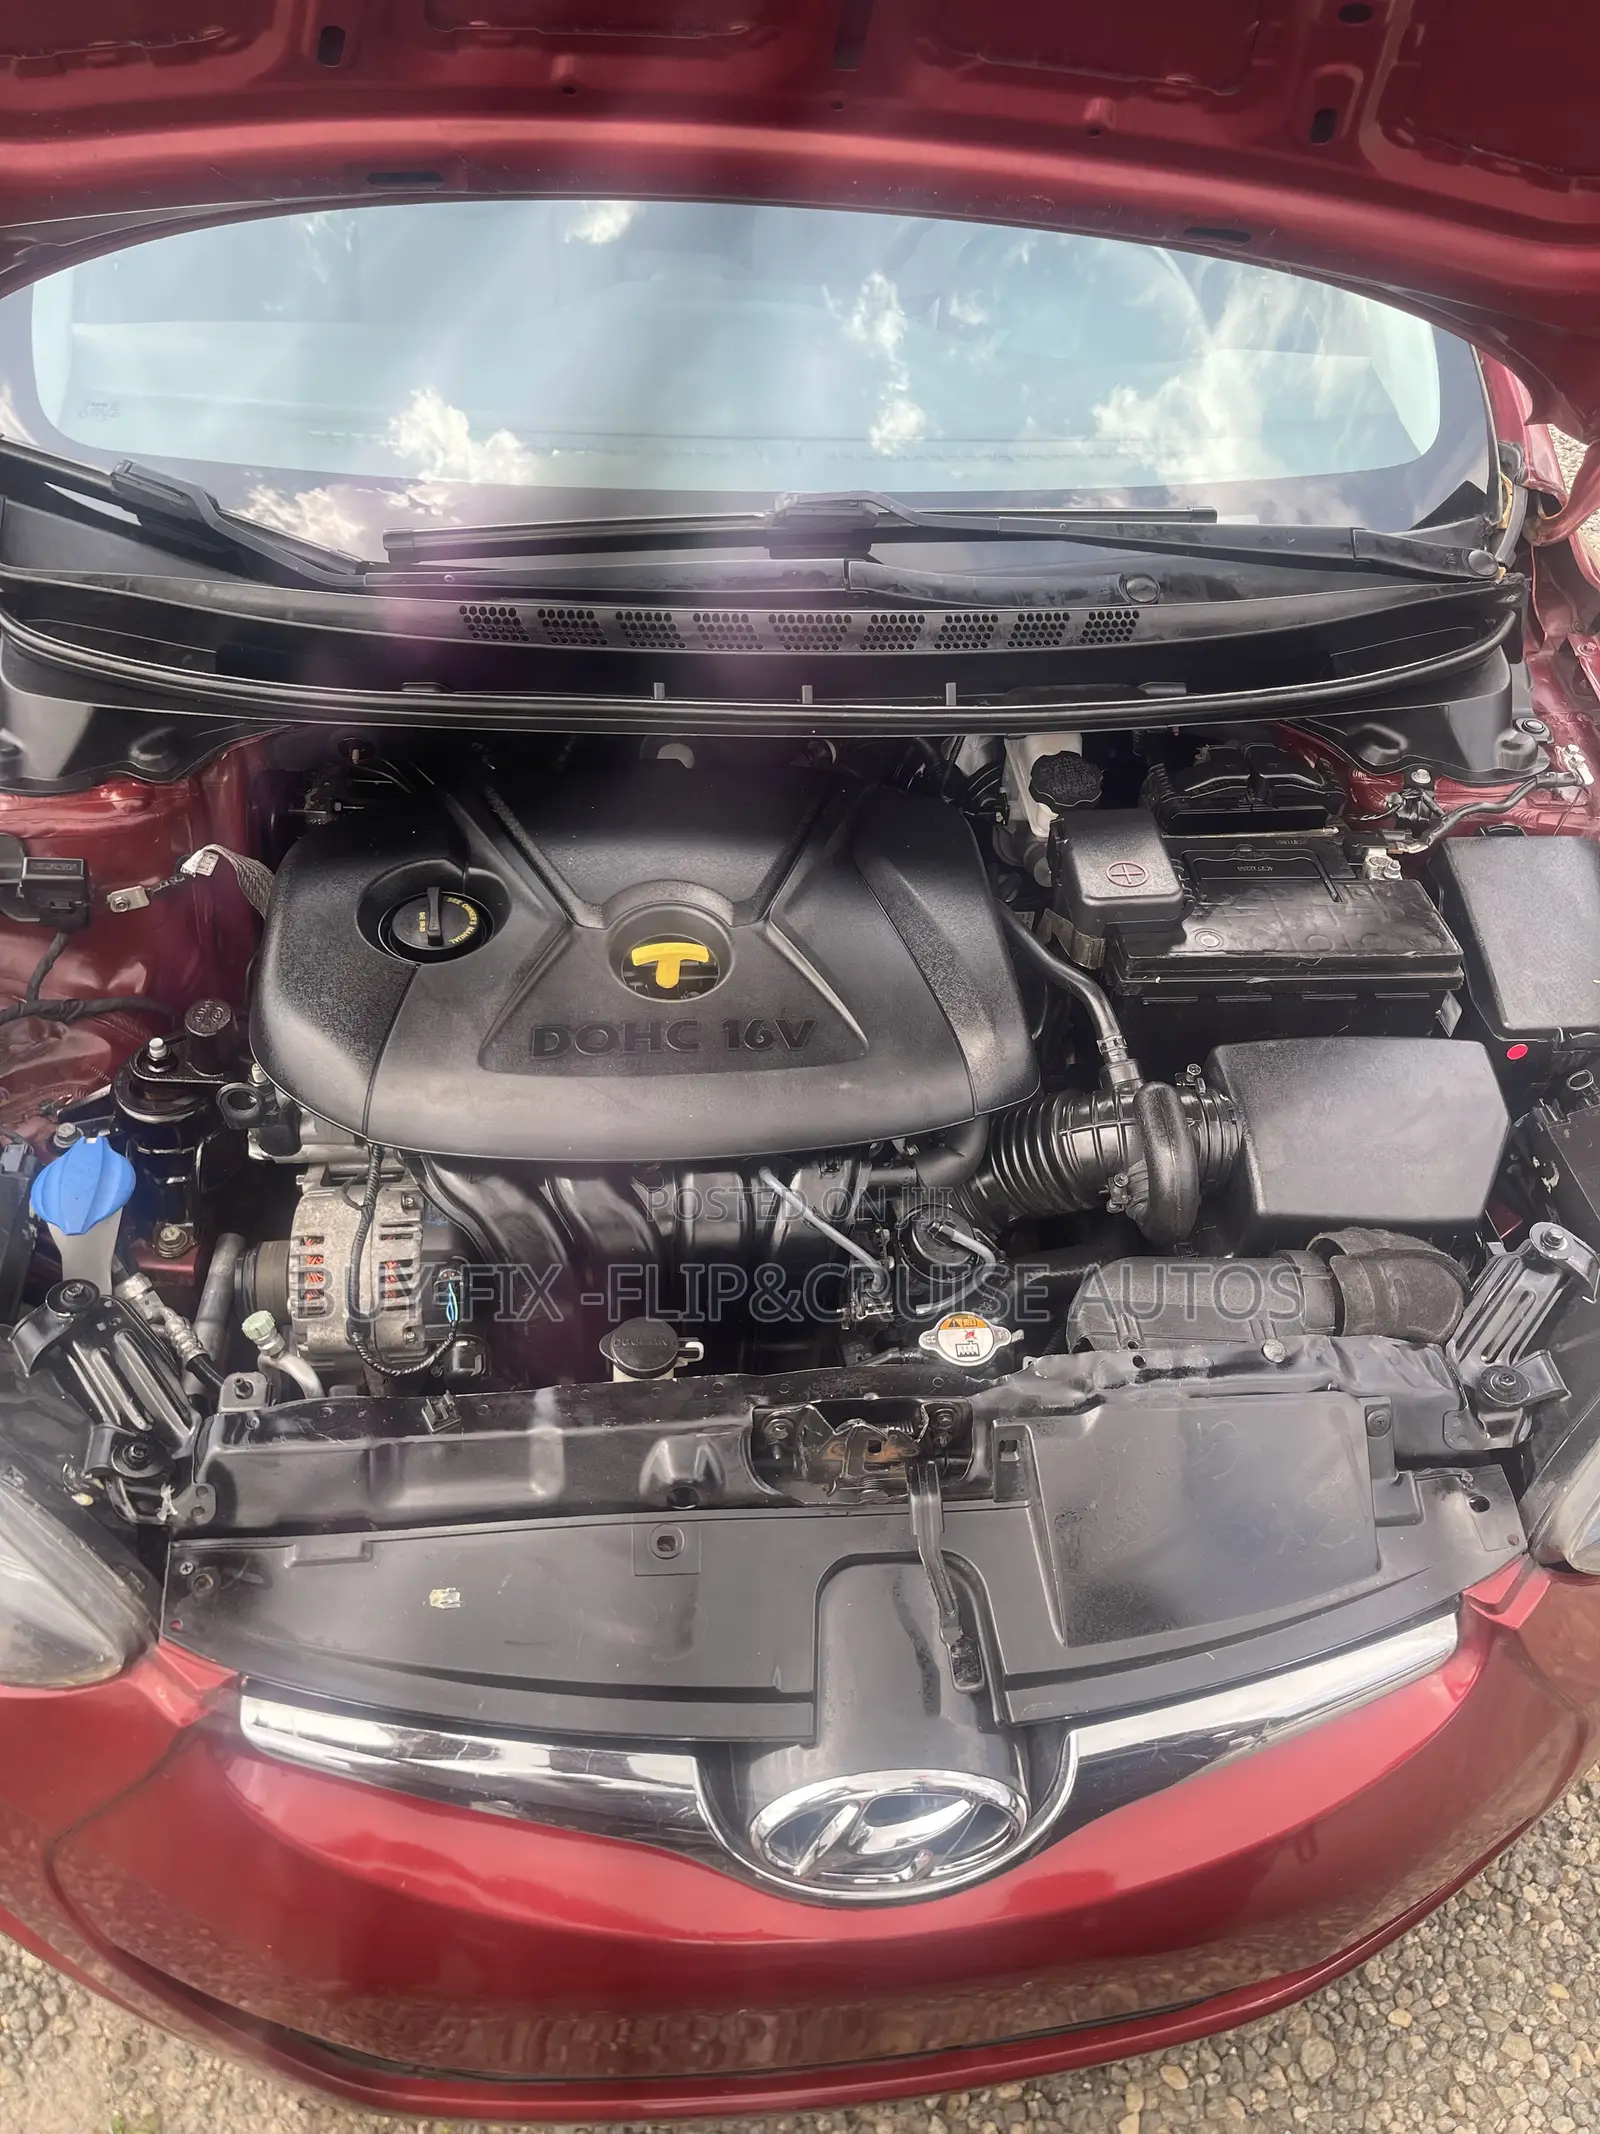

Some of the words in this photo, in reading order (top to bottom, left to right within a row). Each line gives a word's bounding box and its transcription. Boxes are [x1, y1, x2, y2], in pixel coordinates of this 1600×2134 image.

[447, 897, 463, 905] SEE
[448, 926, 475, 944] MANUAL
[531, 1018, 701, 1060] DOHC
[721, 1017, 817, 1051] 16V
